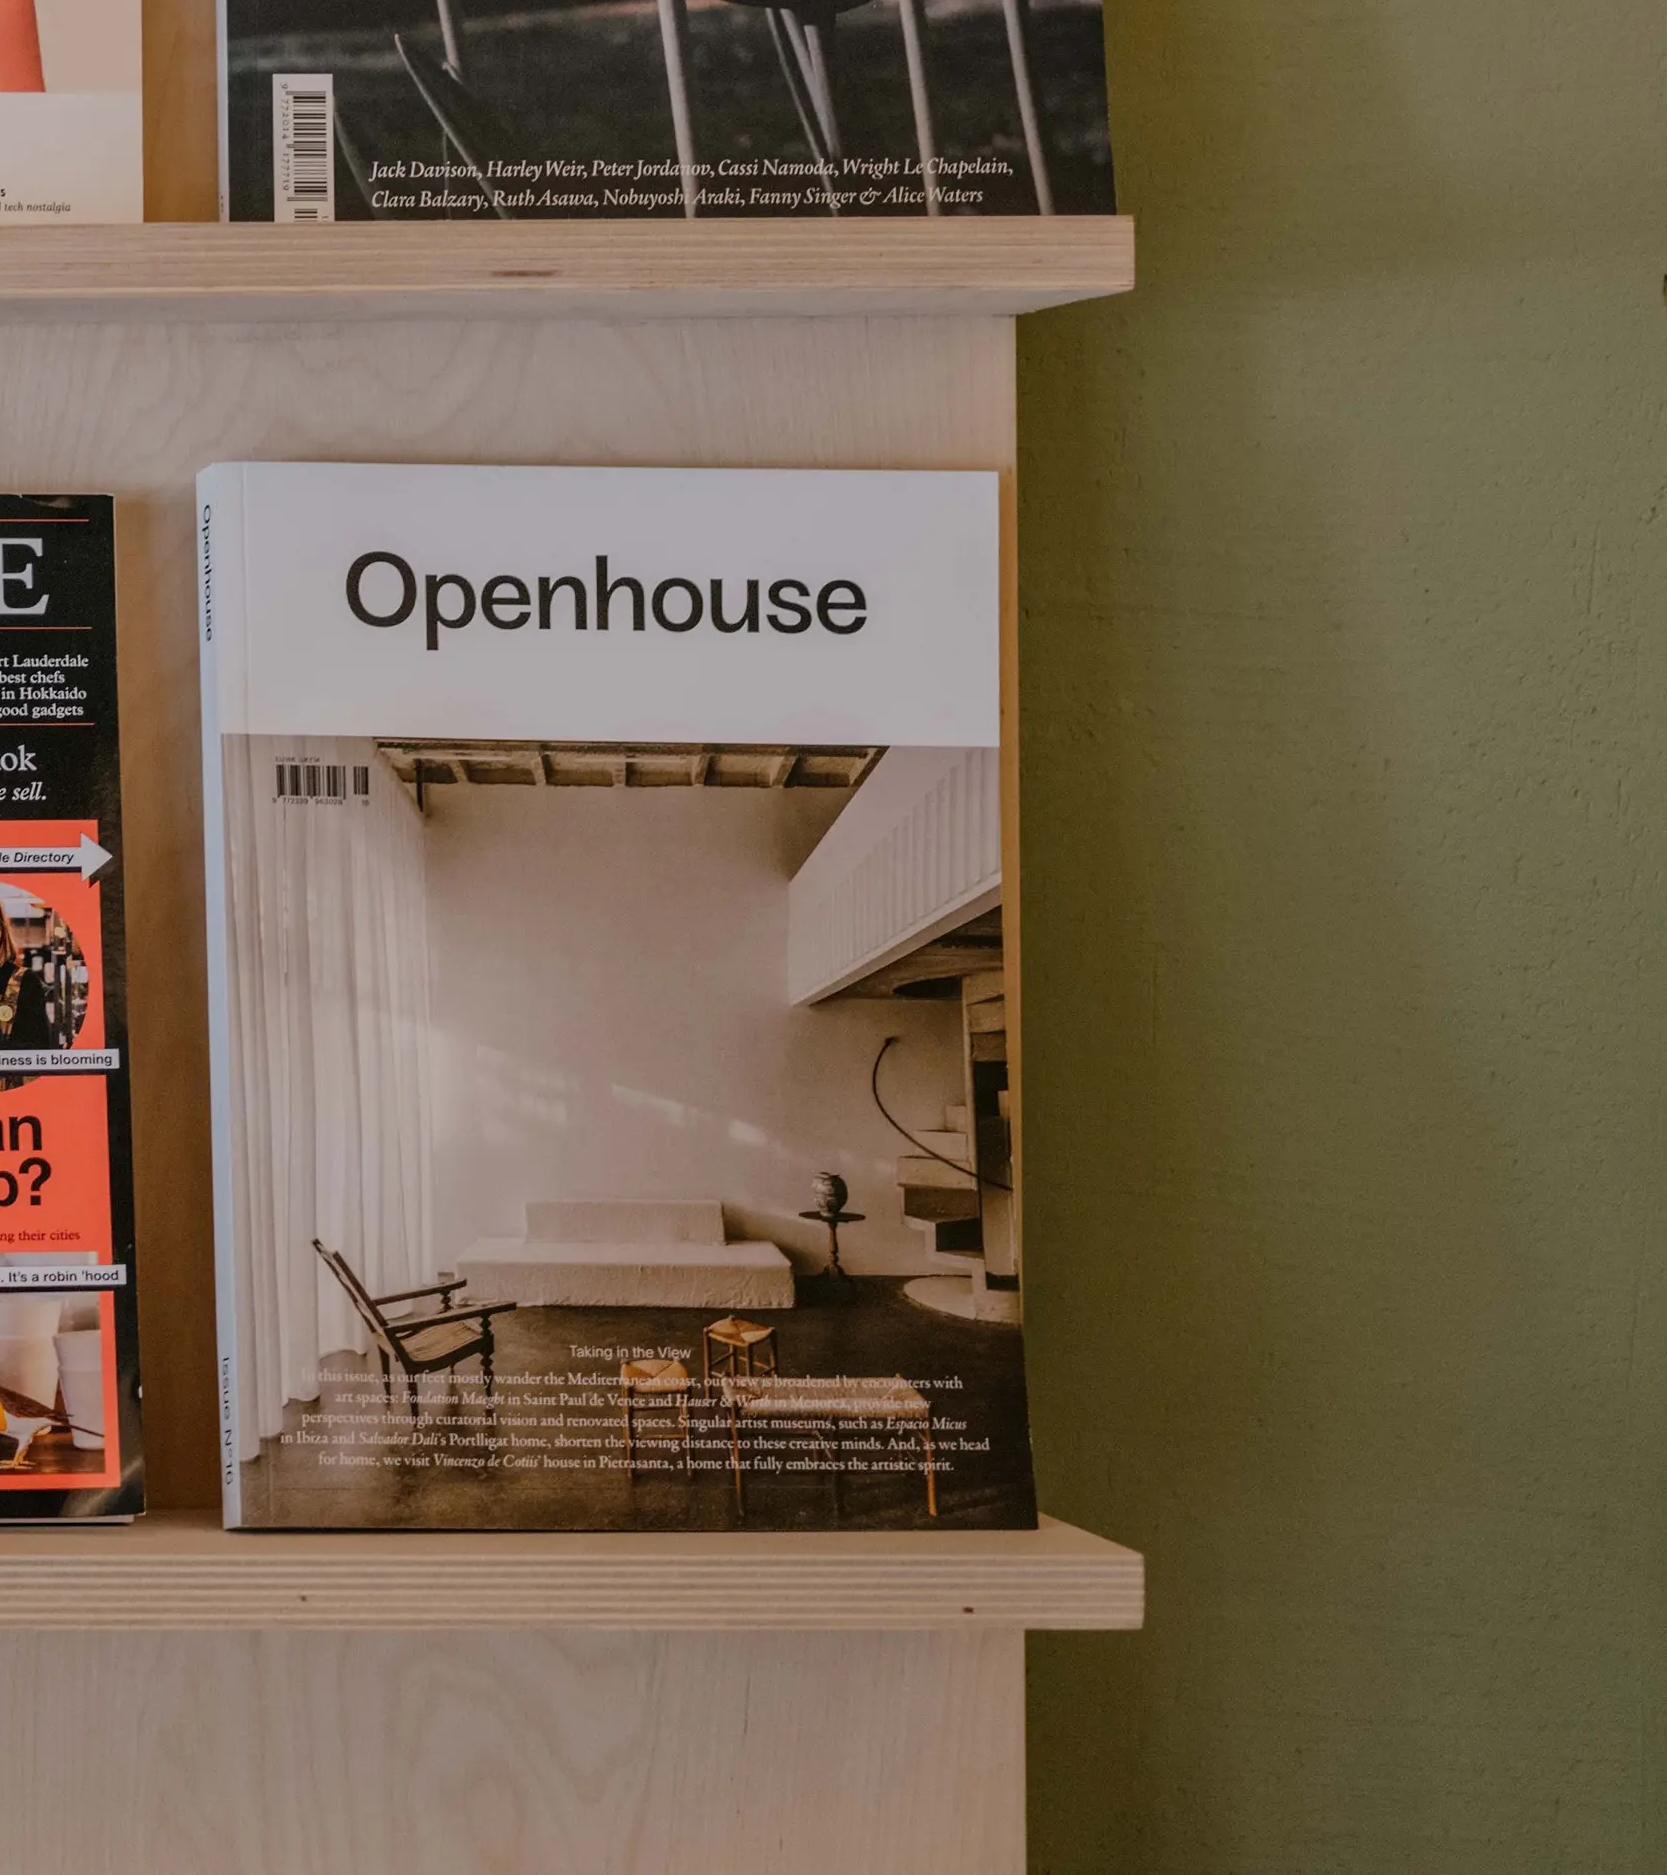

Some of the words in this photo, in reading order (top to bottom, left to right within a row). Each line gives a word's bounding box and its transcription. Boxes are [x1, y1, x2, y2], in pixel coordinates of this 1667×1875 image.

[367, 160, 405, 182] Jack
[409, 160, 482, 181] Davison,
[486, 159, 542, 182] Harley
[545, 159, 587, 179] Weir,
[591, 159, 634, 176] Peter
[717, 158, 758, 176] Cassi
[761, 159, 839, 177] Namoda,
[843, 157, 900, 179] Wright
[903, 158, 924, 175] Le
[201, 505, 213, 641] Openhouse
[345, 551, 867, 651] Openhouse
[13, 851, 74, 864] Directory
[36, 1054, 47, 1065] is
[50, 1053, 112, 1067] blooming
[31, 1273, 39, 1282] a
[43, 1271, 77, 1281] robin
[569, 1345, 613, 1361] Taking
[617, 1345, 628, 1358] in
[632, 1345, 655, 1359] the
[657, 1346, 691, 1359] View
